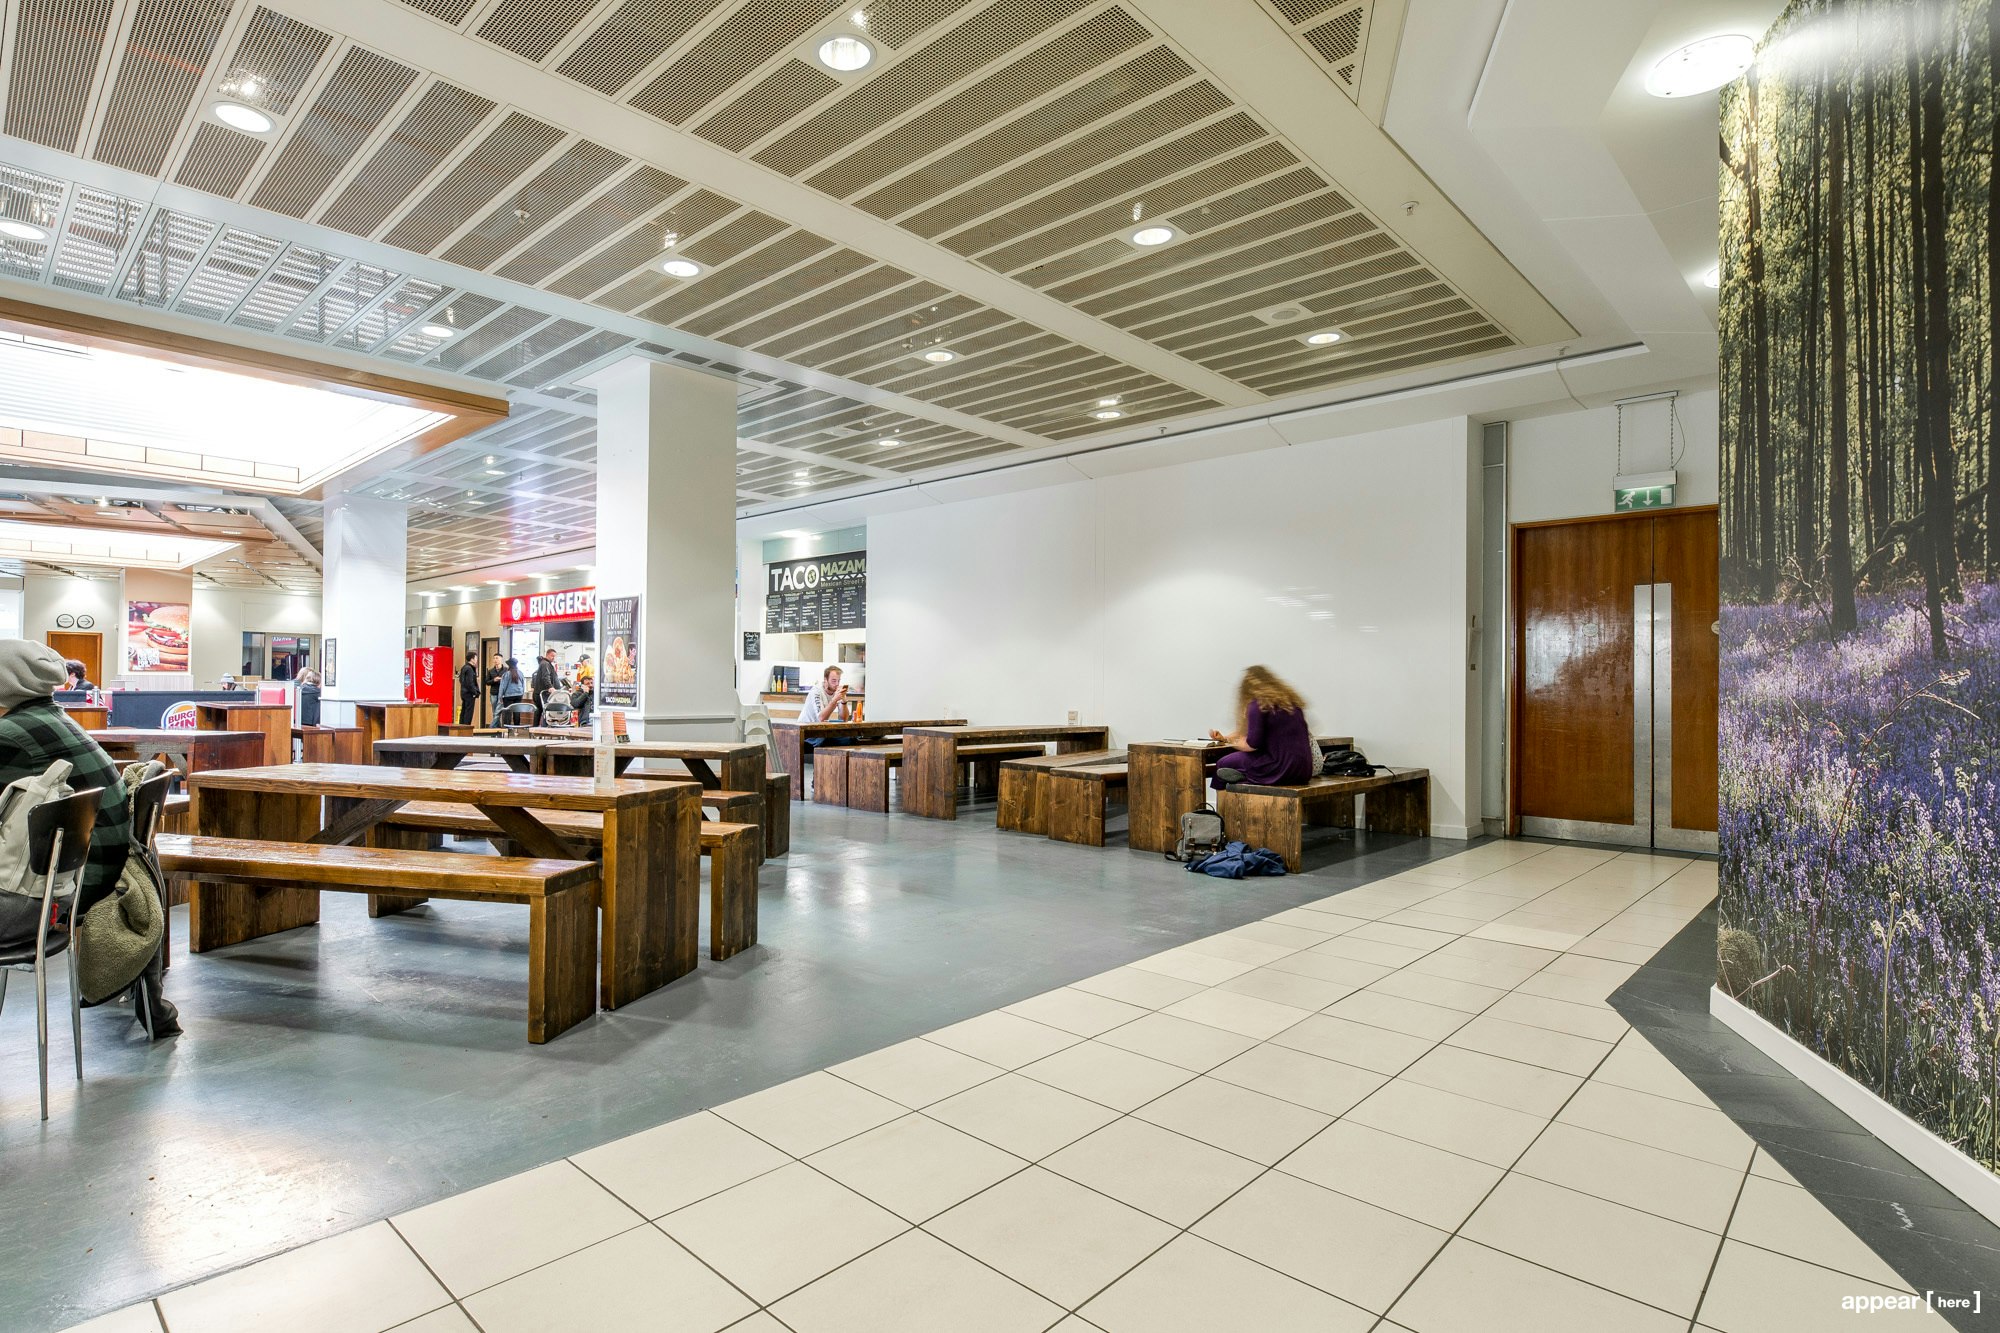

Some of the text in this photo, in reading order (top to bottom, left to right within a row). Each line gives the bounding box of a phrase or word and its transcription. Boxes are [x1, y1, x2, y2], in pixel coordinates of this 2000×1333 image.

[771, 558, 866, 591] TACO MAZAM
[529, 592, 583, 618] BURGER
[607, 600, 632, 614] BURRITO
[607, 612, 632, 629] LUNCH!
